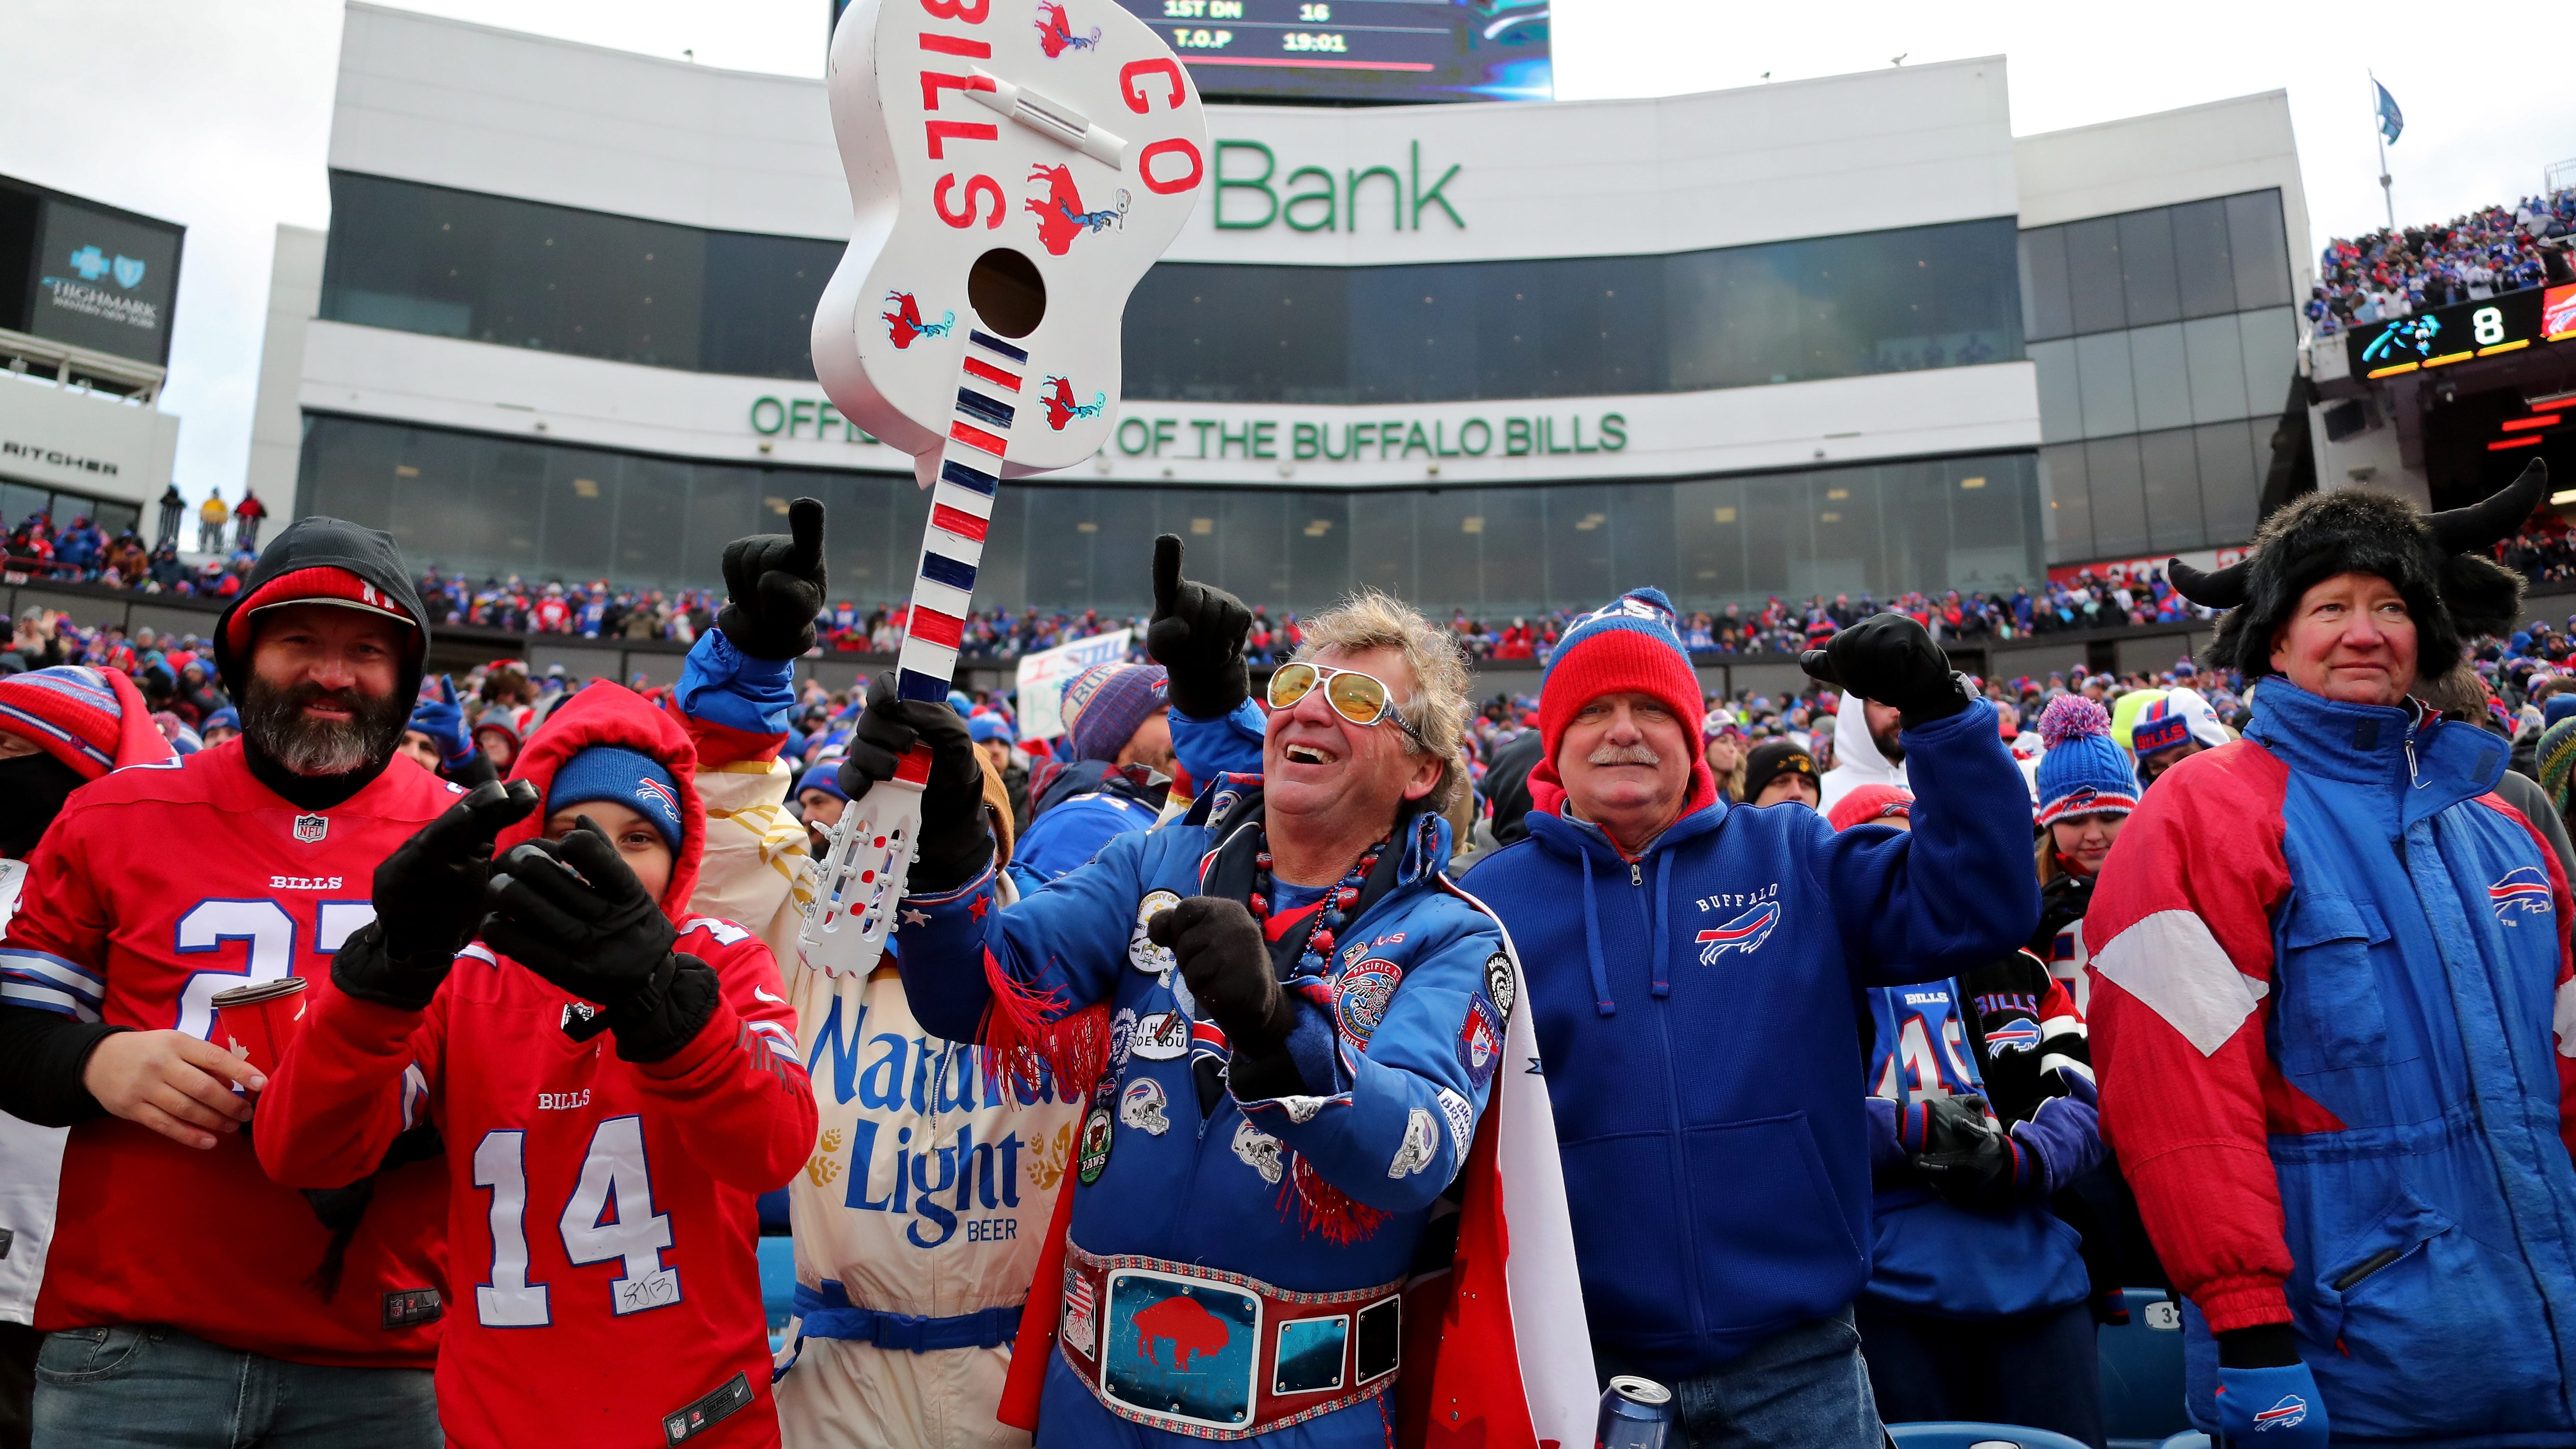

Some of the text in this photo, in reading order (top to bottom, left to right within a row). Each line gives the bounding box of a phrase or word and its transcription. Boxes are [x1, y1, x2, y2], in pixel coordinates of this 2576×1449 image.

[1164, 0, 1243, 19] 1ST DN
[1299, 3, 1331, 22] 16
[1174, 29, 1233, 48] T.O.P
[1283, 32, 1348, 53] 19:01
[918, 0, 1006, 230] BILLS
[1119, 57, 1203, 195] GO
[1214, 139, 1465, 232] Bank
[53, 280, 157, 317] HIGHMARK
[2473, 307, 2503, 344] 8
[1117, 416, 1178, 455] OF
[1191, 420, 1277, 458] THE
[1293, 417, 1492, 460] BUFFALO
[1505, 413, 1628, 456] BILLS
[3, 441, 118, 475] RITCHER
[1071, 665, 1113, 707] BUF
[2136, 724, 2186, 750] BILLS
[299, 826, 320, 837] NFL
[269, 876, 343, 890] BILLS
[1696, 883, 1778, 912] BUFFALO
[1135, 922, 1146, 931] UGBY
[2501, 919, 2517, 927] TM
[1353, 962, 1391, 976] PACIFIC
[1904, 991, 1949, 1005] BILLS
[1477, 1021, 1493, 1048] 1960
[806, 995, 1081, 1117] Natural
[538, 1089, 590, 1110] BILLS
[1456, 1099, 1470, 1124] BIG
[1082, 1152, 1106, 1171] PAWS
[844, 1118, 1025, 1249] Light
[473, 1113, 684, 1329] 14
[967, 1218, 1017, 1243] BEER
[2162, 1308, 2172, 1323] 3
[675, 1426, 686, 1436] NFL
